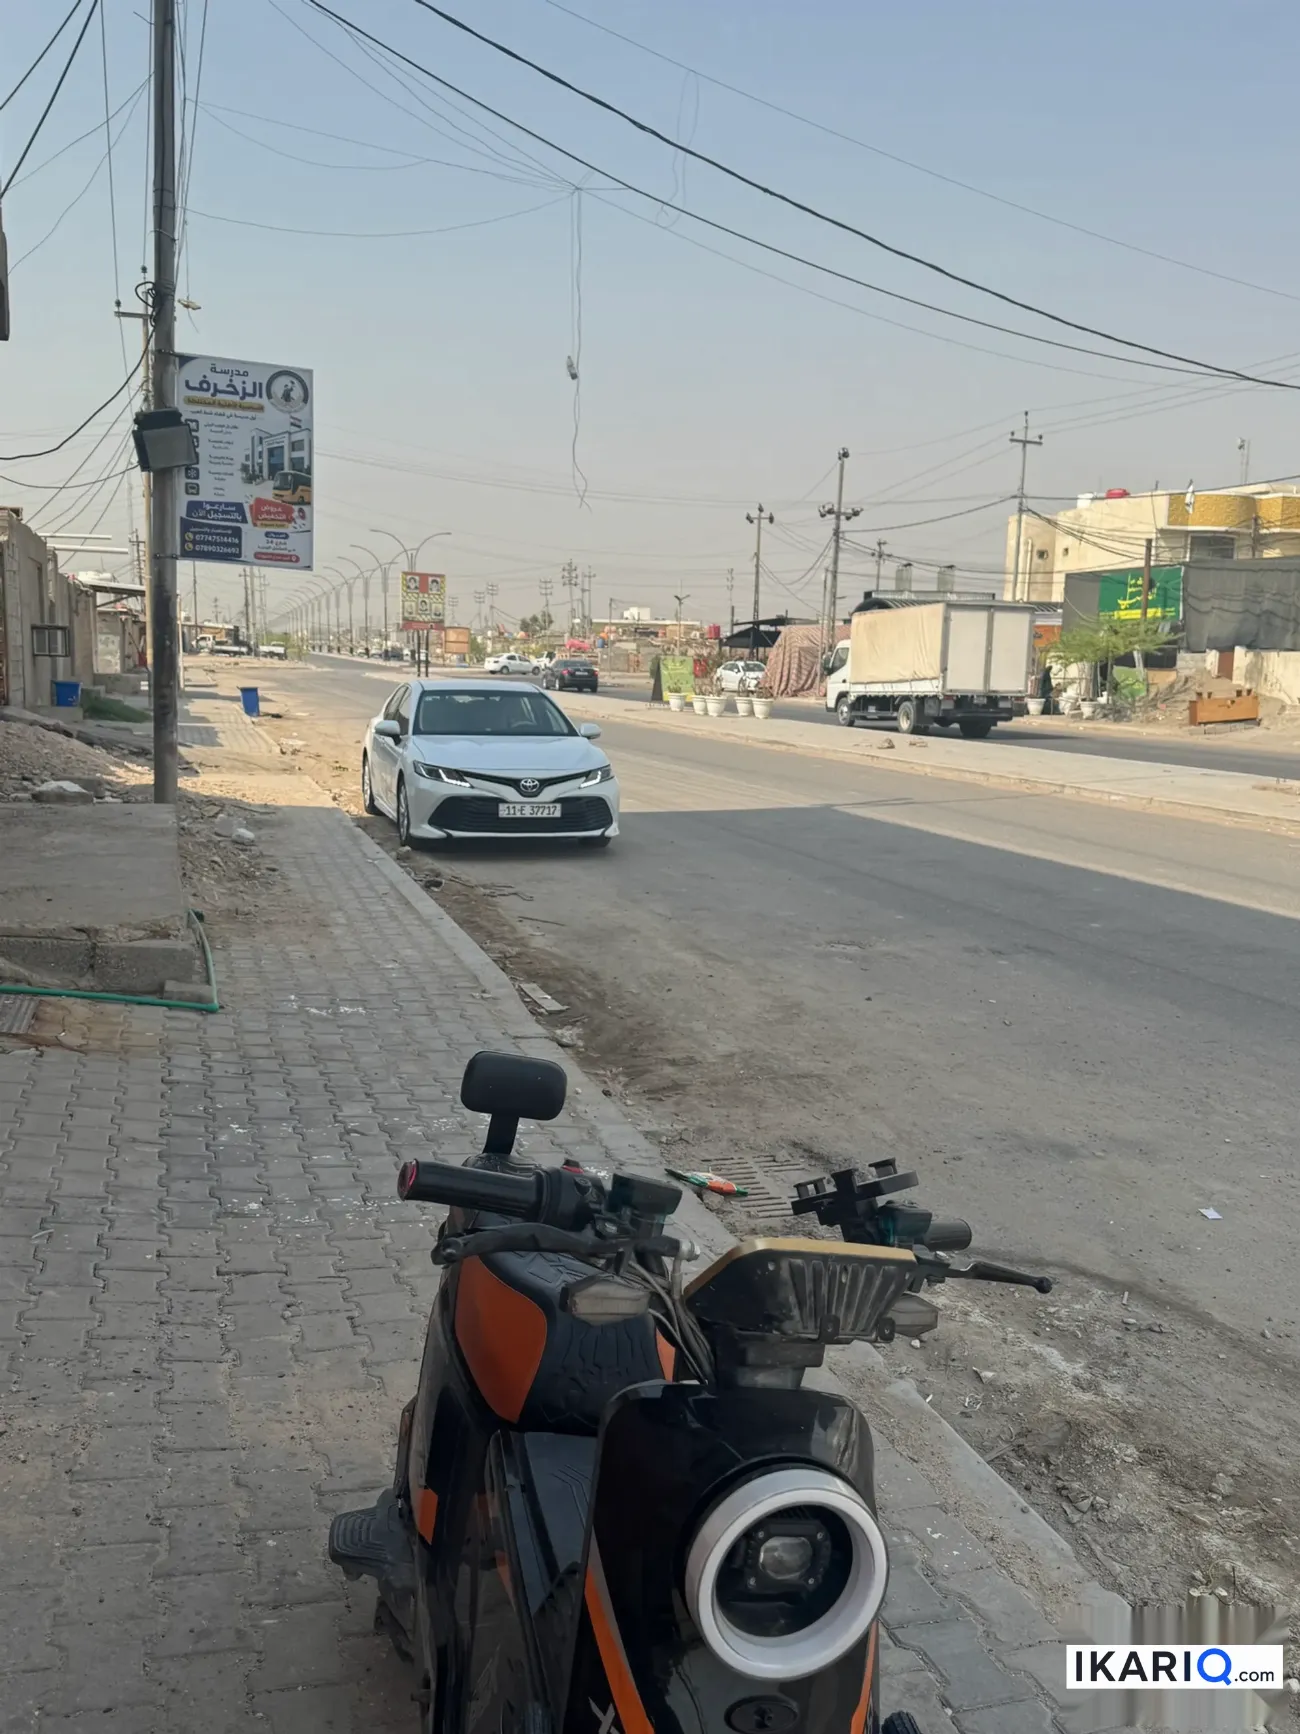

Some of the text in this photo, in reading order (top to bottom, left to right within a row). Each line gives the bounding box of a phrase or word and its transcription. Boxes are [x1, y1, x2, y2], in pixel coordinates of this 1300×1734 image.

[210, 363, 249, 377] مدرسة
[184, 374, 263, 400] الزخرف
[202, 501, 236, 511] سارعوا
[260, 504, 282, 512] عروض
[207, 505, 242, 522] بالتسجيل
[529, 805, 558, 816] 37717
